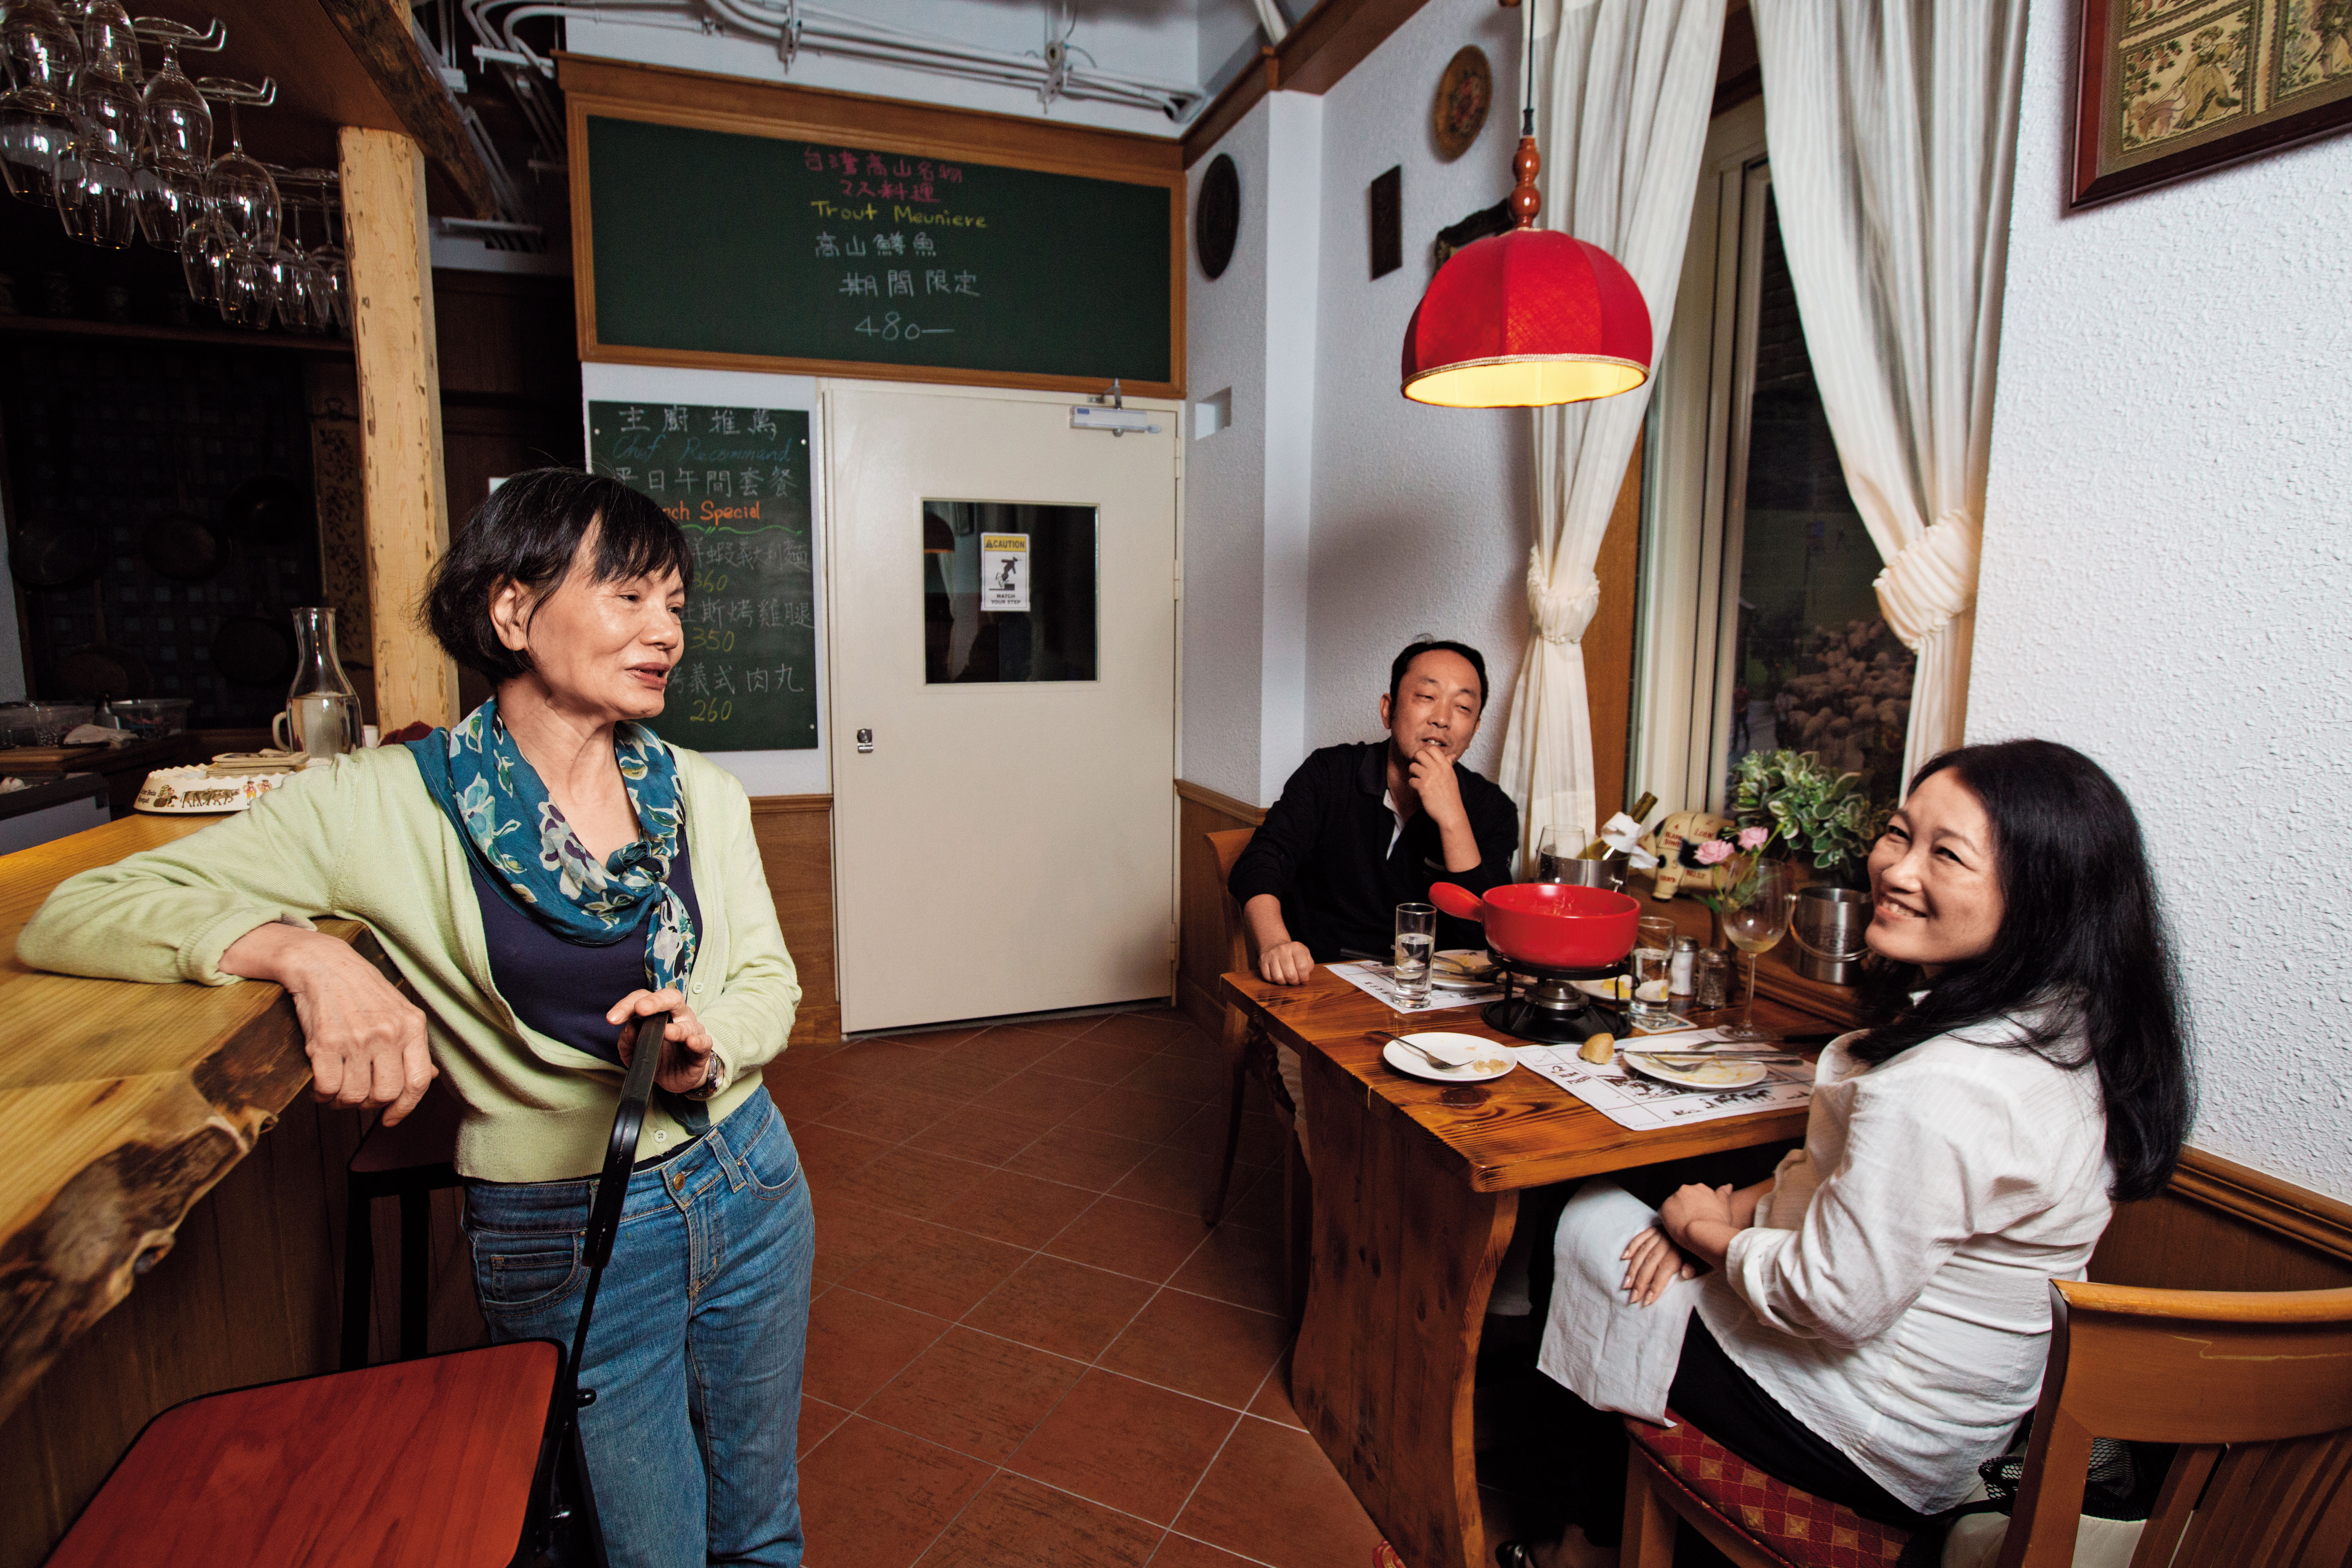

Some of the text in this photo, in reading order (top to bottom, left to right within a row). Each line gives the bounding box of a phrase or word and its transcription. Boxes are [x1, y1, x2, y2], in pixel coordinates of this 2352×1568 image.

[811, 200, 988, 228] Trout Meuniere
[839, 269, 980, 297] 期間限定
[662, 500, 760, 526] nch Special
[993, 539, 1025, 548] CAUTION
[693, 569, 728, 593] 360
[690, 627, 734, 653] 350
[690, 697, 732, 722] 260
